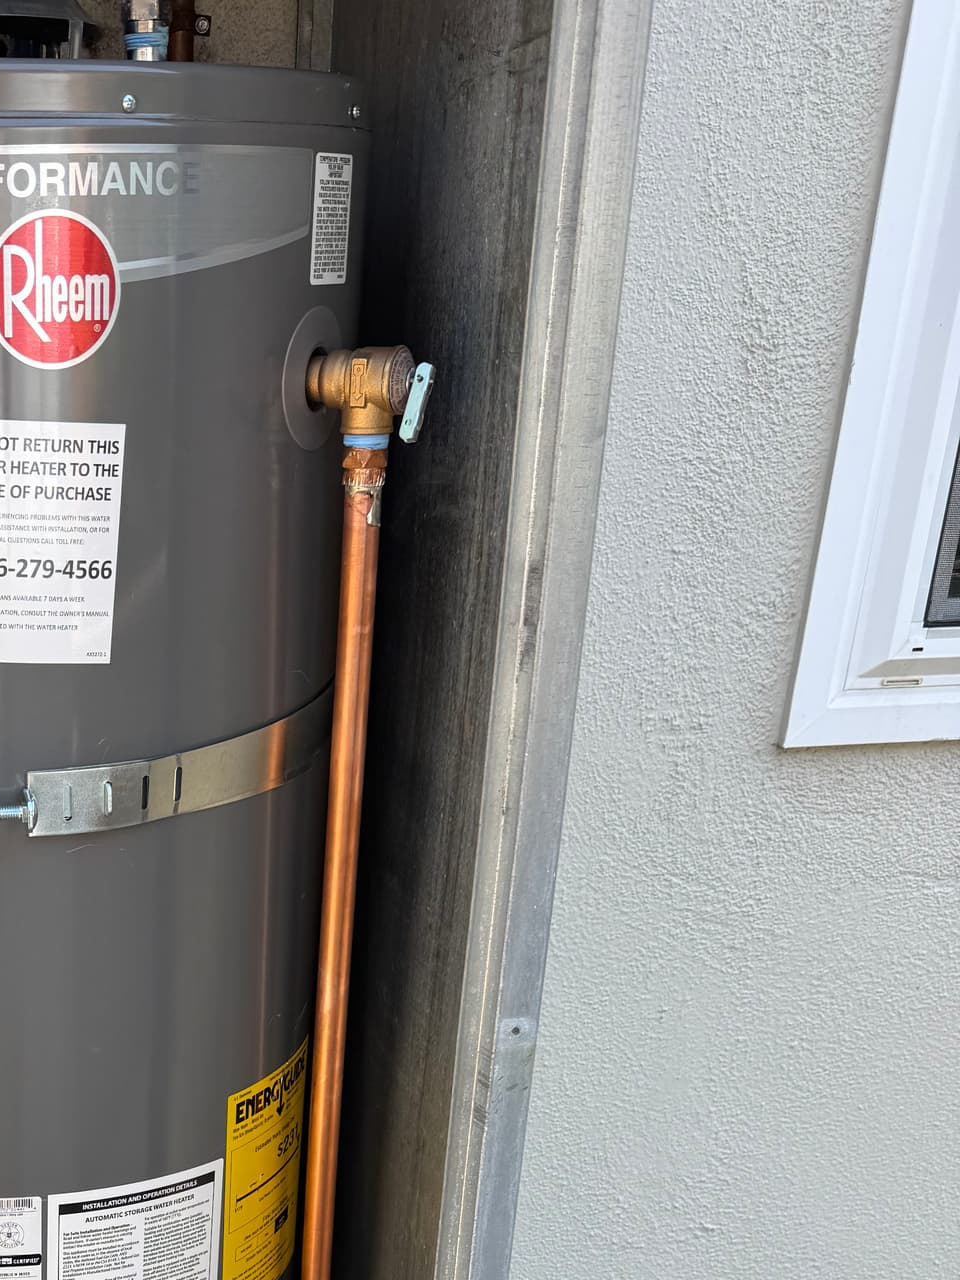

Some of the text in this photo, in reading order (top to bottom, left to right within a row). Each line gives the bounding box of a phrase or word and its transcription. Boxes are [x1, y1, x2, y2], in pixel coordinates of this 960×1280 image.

[2, 219, 110, 342] Rheem
[24, 438, 84, 454] RETURN
[88, 440, 120, 455] THIS
[10, 460, 66, 476] HEATER
[70, 462, 90, 477] TO
[94, 463, 120, 478] THE
[10, 484, 31, 499] OF
[34, 486, 112, 501] PURCHASE
[8, 536, 40, 544] QUESTIONS
[82, 1180, 198, 1210] INSTALLATION AND OPERATION DETAILS
[85, 1194, 195, 1223] AUTOMATIC STORAGE WATER HEATER
